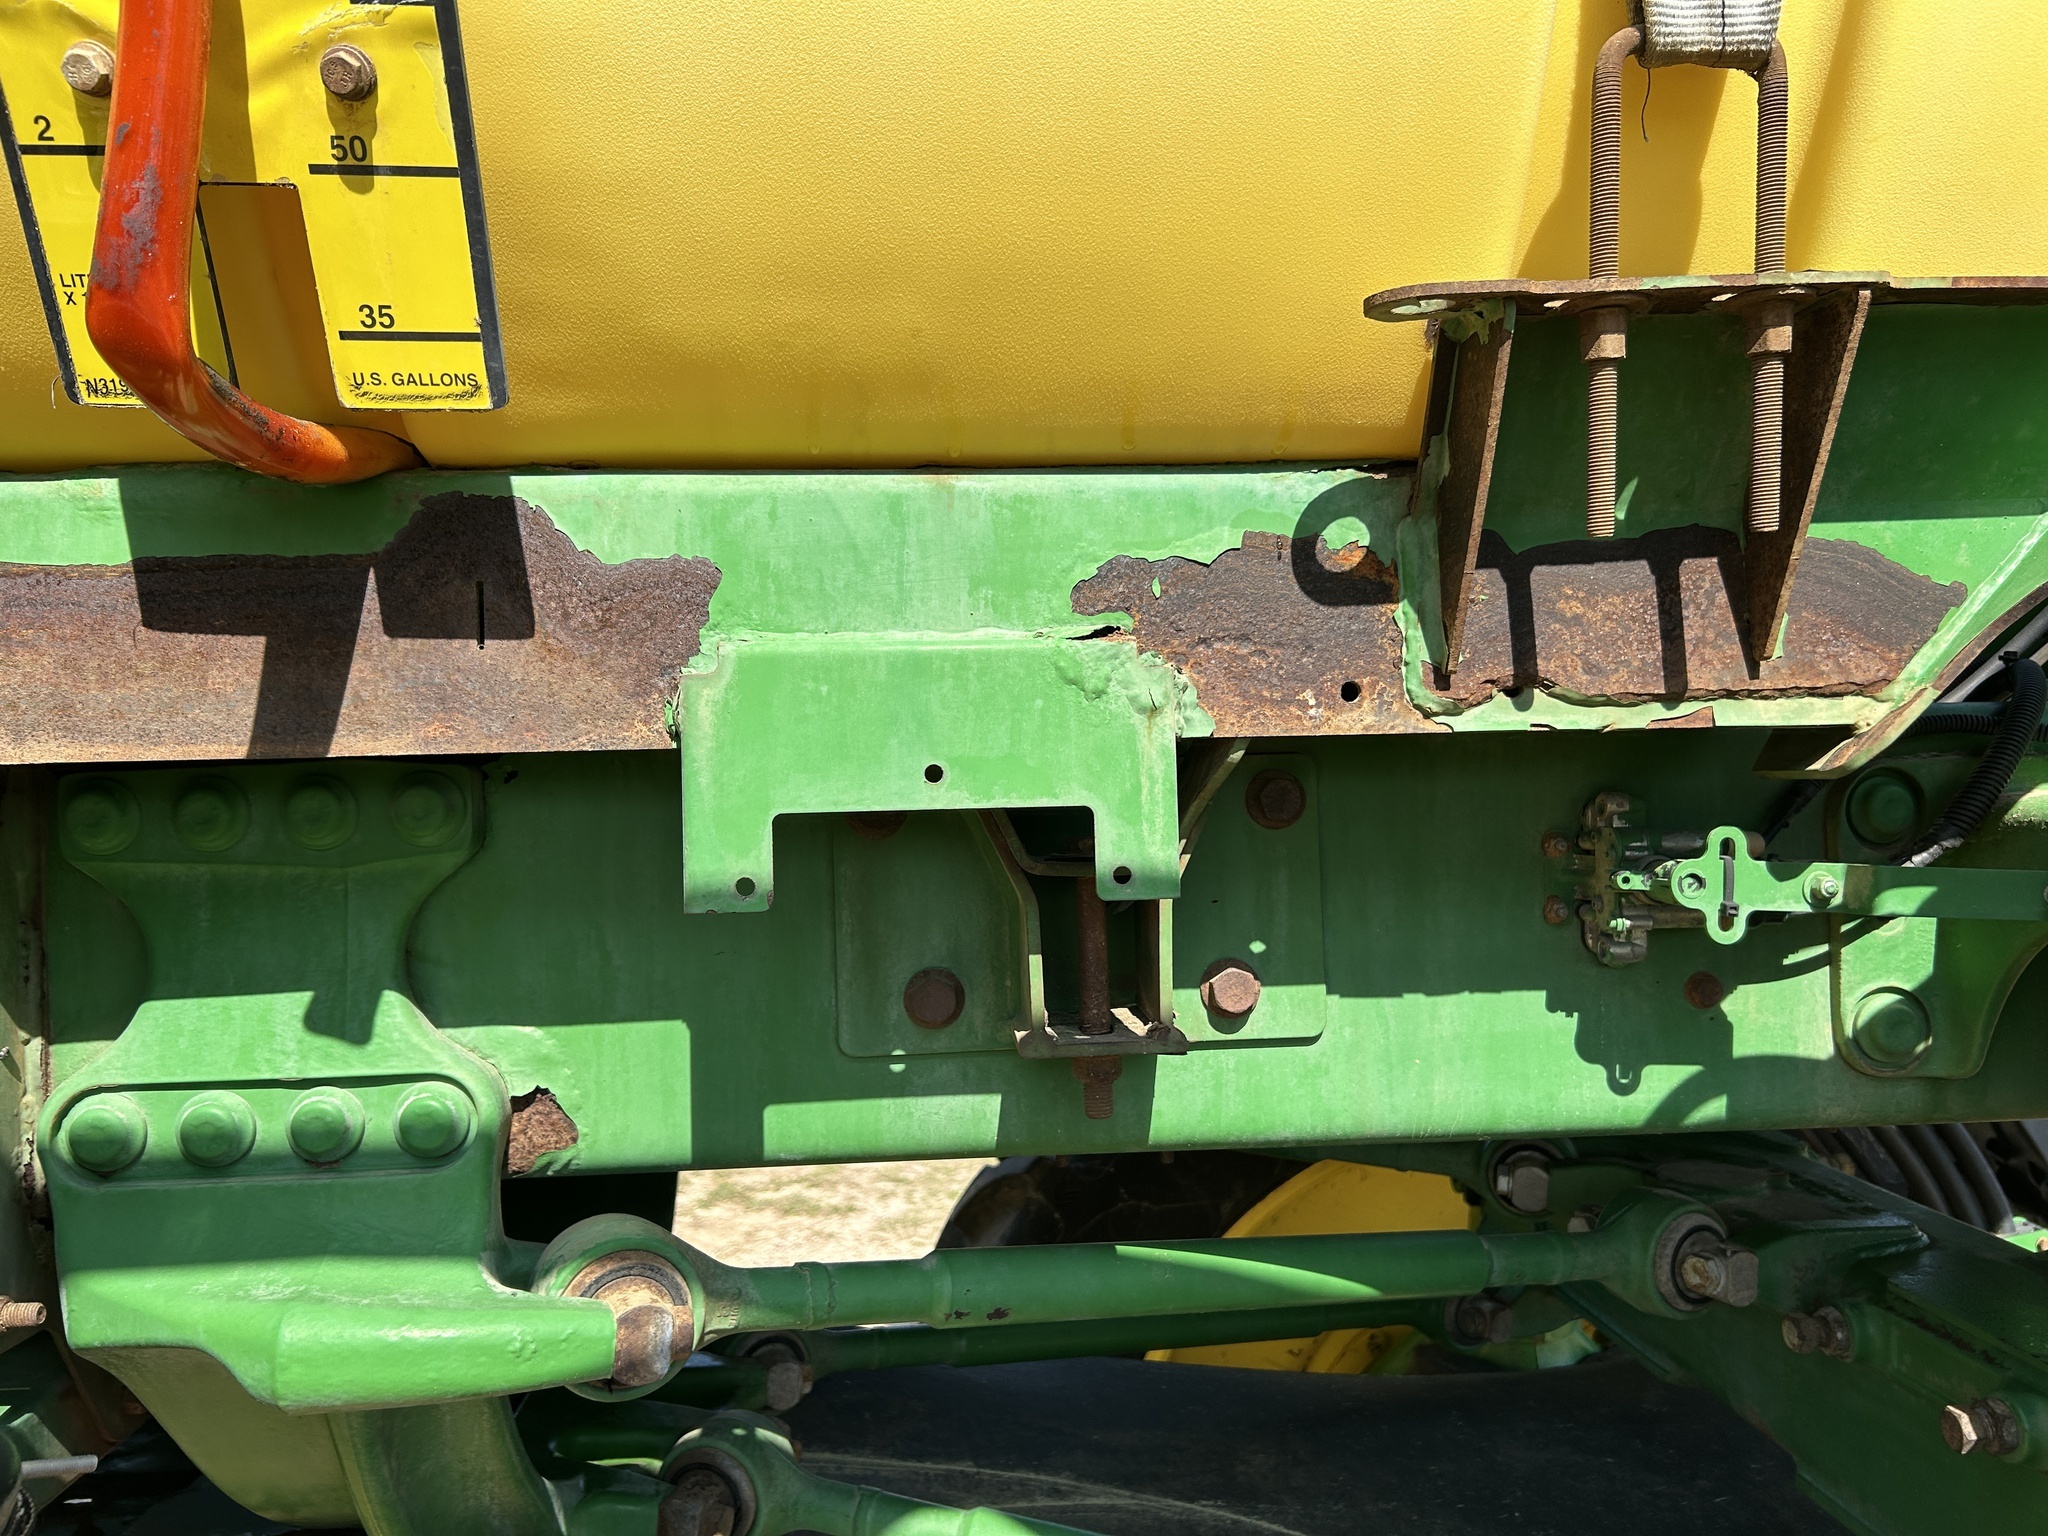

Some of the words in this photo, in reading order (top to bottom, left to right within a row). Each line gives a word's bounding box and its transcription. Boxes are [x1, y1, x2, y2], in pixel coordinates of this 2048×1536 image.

[33, 114, 55, 142] 2
[330, 135, 368, 163] 50
[59, 273, 90, 288] LIT
[63, 291, 77, 305] X
[358, 304, 396, 329] 35
[352, 372, 387, 386] U.S.
[391, 372, 479, 387] GALLONS
